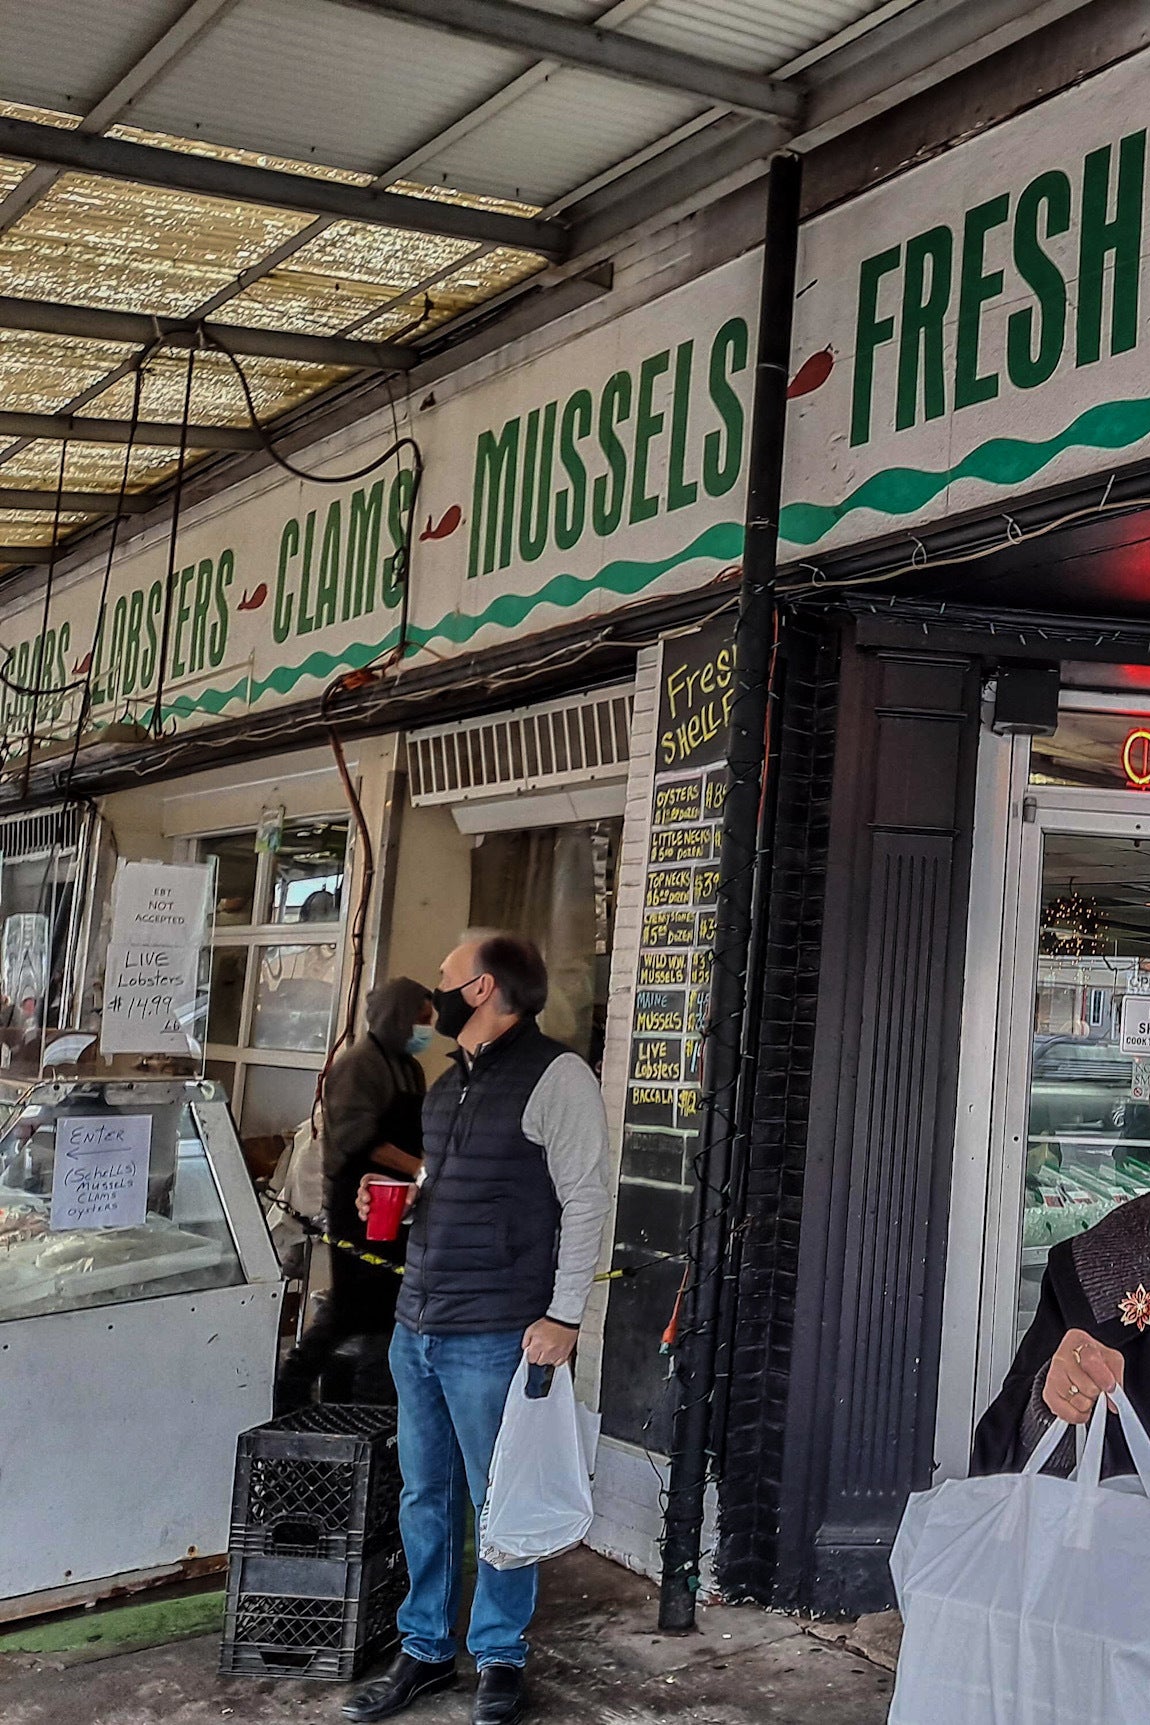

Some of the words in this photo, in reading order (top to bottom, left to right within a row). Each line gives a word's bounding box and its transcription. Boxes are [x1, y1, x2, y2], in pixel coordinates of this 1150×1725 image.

[273, 468, 412, 644] CLAMS
[467, 317, 748, 580] MUSSELS
[849, 128, 1147, 448] FRESH
[667, 644, 737, 719] Fres
[656, 784, 699, 808] OYSTERS
[652, 830, 683, 847] LITTLE
[683, 828, 711, 846] NECKS
[647, 871, 665, 890] TOP
[664, 871, 690, 887] NECKS
[153, 887, 172, 898] EBT
[148, 901, 175, 911] NOT
[134, 914, 185, 925] ACCEPTED
[125, 950, 170, 969] LIVE
[643, 953, 667, 969] WILD
[117, 969, 185, 989] Lobsters
[640, 968, 684, 985] MUSSELS
[636, 991, 668, 1009] MAINE
[636, 1011, 682, 1032] MUSSELS
[1126, 1036, 1147, 1046] COOK
[638, 1041, 667, 1061] LIVE
[632, 1087, 674, 1105] BACCALA
